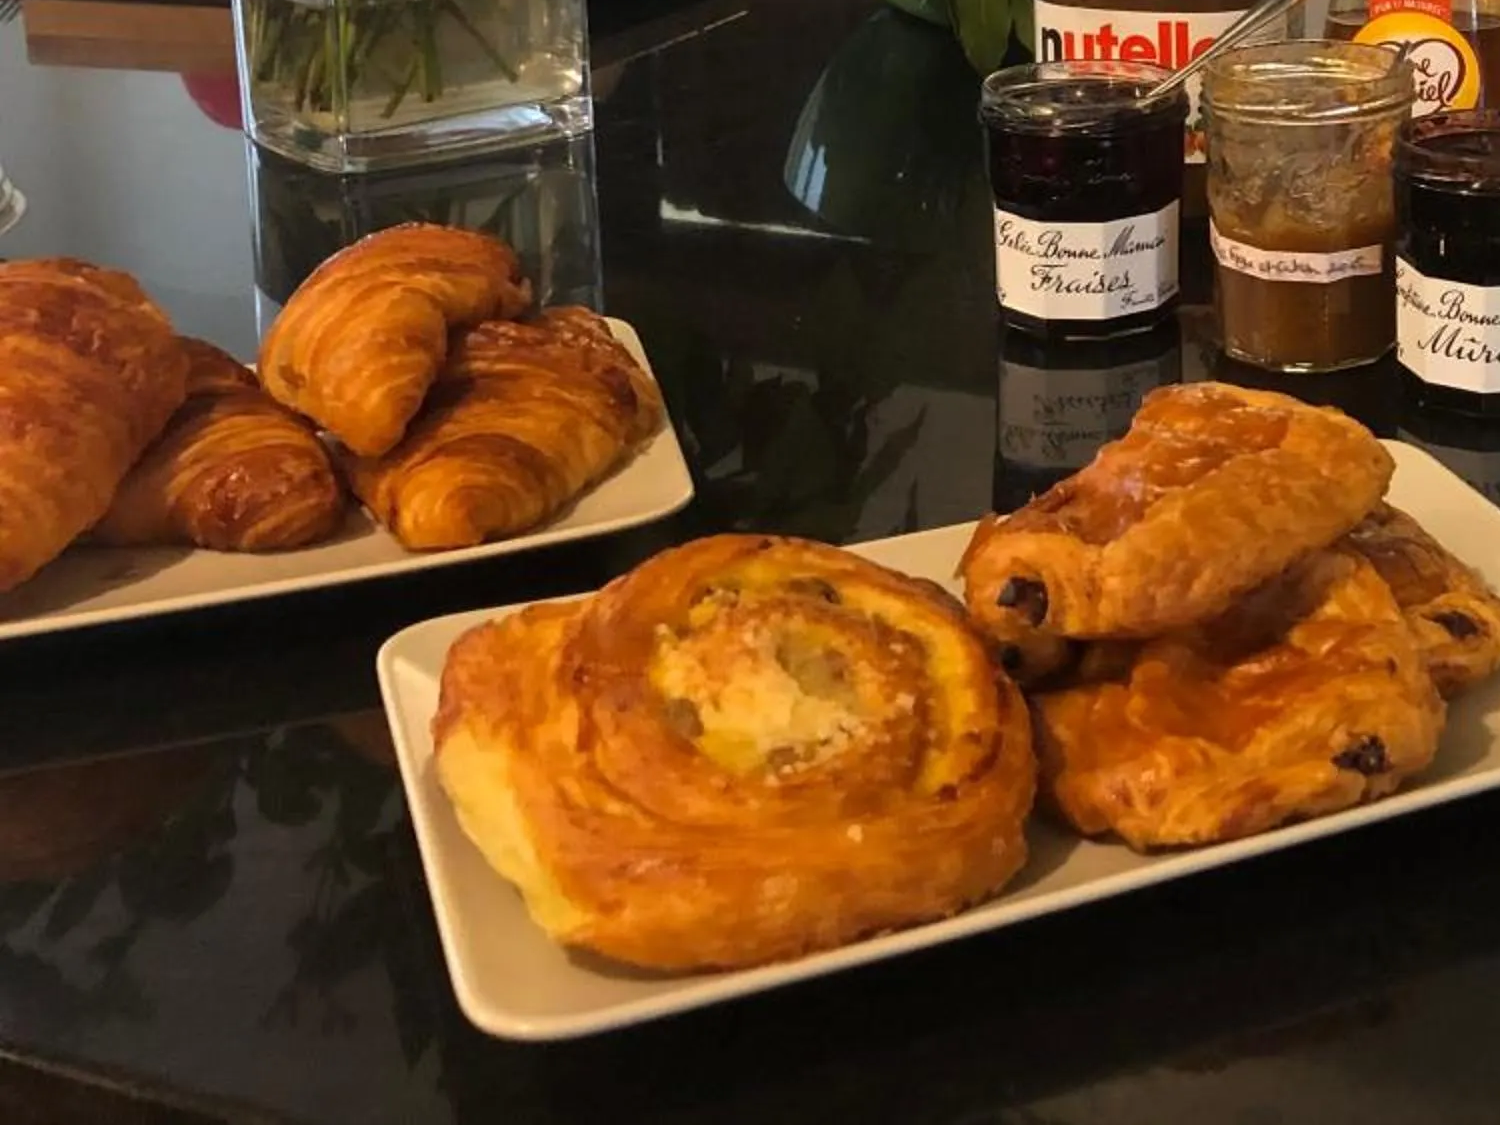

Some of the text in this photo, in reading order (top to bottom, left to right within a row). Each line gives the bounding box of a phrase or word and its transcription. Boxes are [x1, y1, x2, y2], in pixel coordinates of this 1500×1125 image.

[1418, 71, 1453, 107] iel
[1035, 230, 1099, 259] Bonne
[1030, 264, 1135, 295] Fraises
